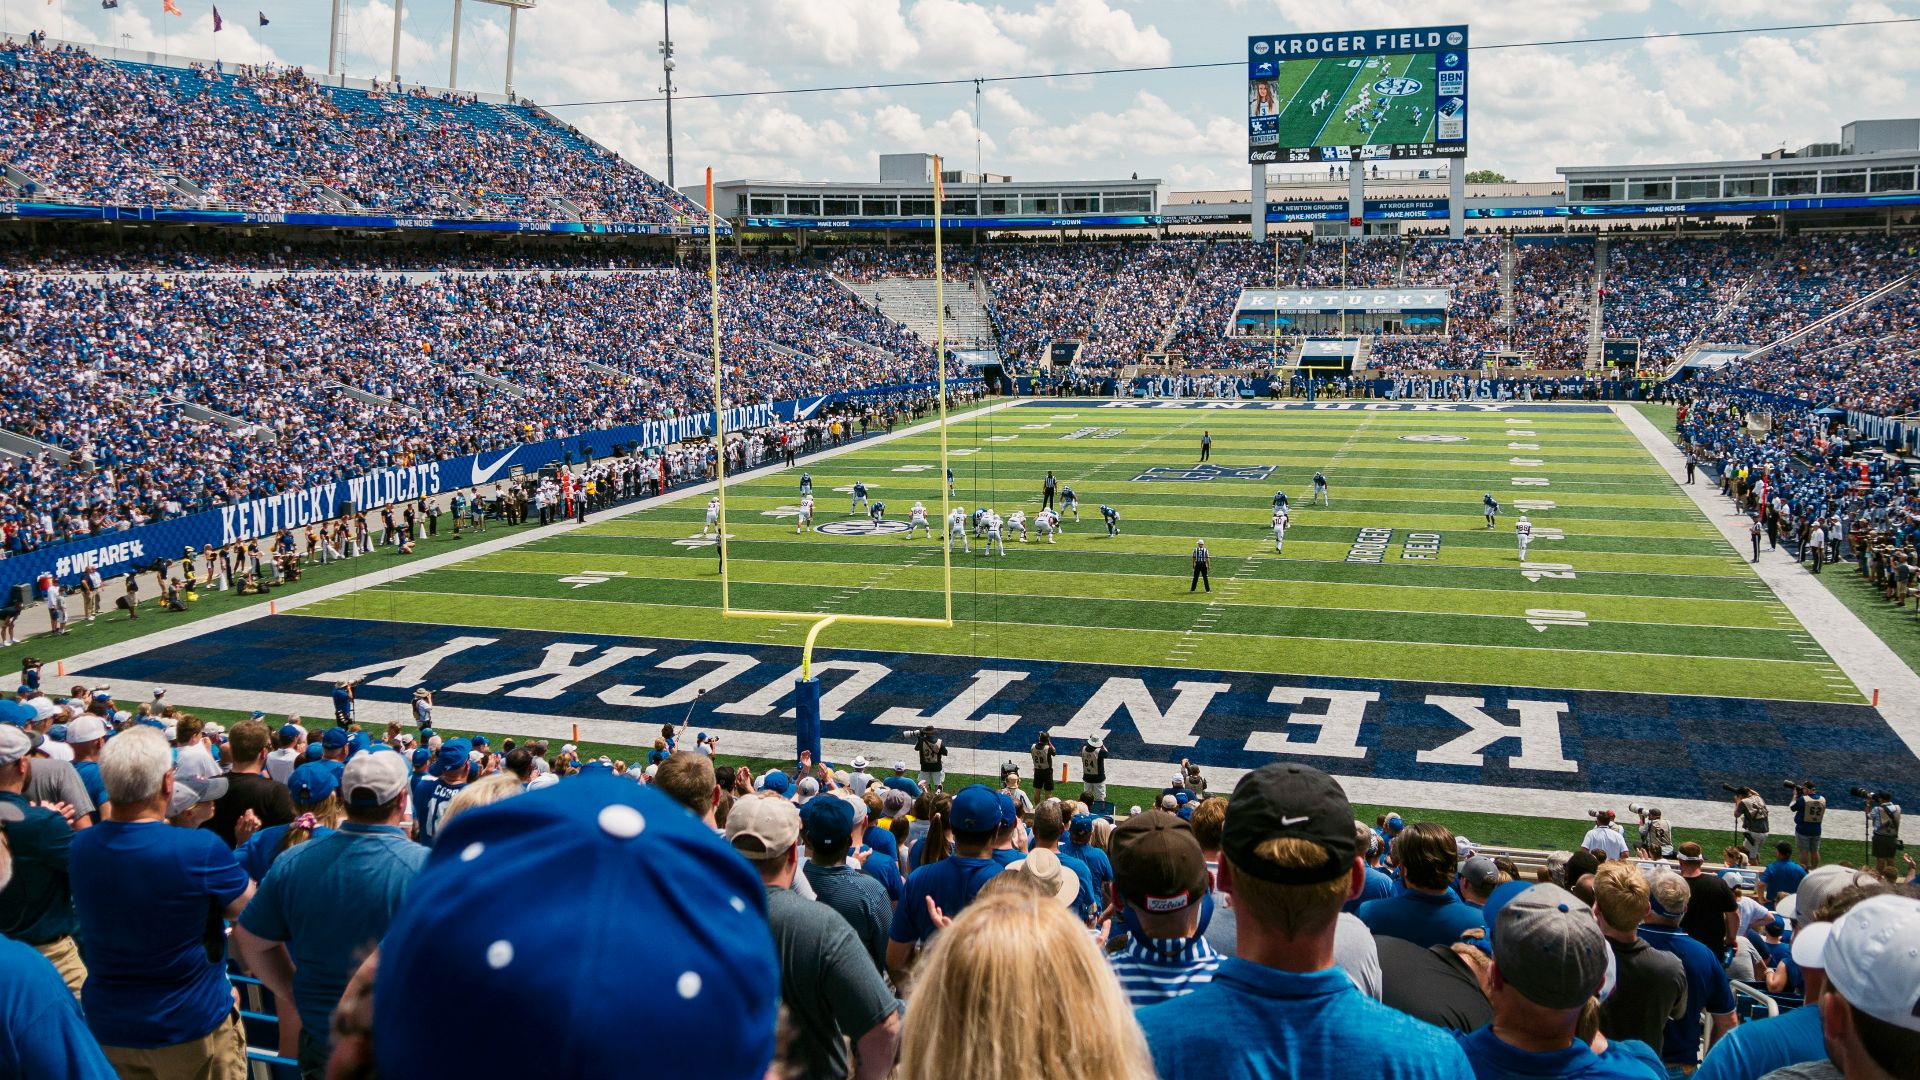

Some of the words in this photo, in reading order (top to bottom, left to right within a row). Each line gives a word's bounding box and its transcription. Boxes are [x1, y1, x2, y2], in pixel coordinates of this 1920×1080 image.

[1273, 36, 1366, 55] KROGER
[1375, 32, 1441, 49] FIELD
[1440, 73, 1463, 82] BBN
[1289, 153, 1310, 161] 5:24
[0, 203, 18, 214] ISE
[257, 212, 285, 223] DOWN
[395, 219, 414, 227] MAKE
[414, 219, 433, 227] NOISE
[530, 222, 551, 231] DOWN
[1250, 295, 1437, 306] KENTUCKY
[1097, 400, 1514, 412] KENTUCKY
[642, 413, 711, 448] KENTUCKY
[347, 461, 440, 512] WILDCATS
[221, 483, 337, 546] KENTUCKY
[1518, 524, 1528, 532] 88
[306, 636, 1580, 774] KENTUCKY
